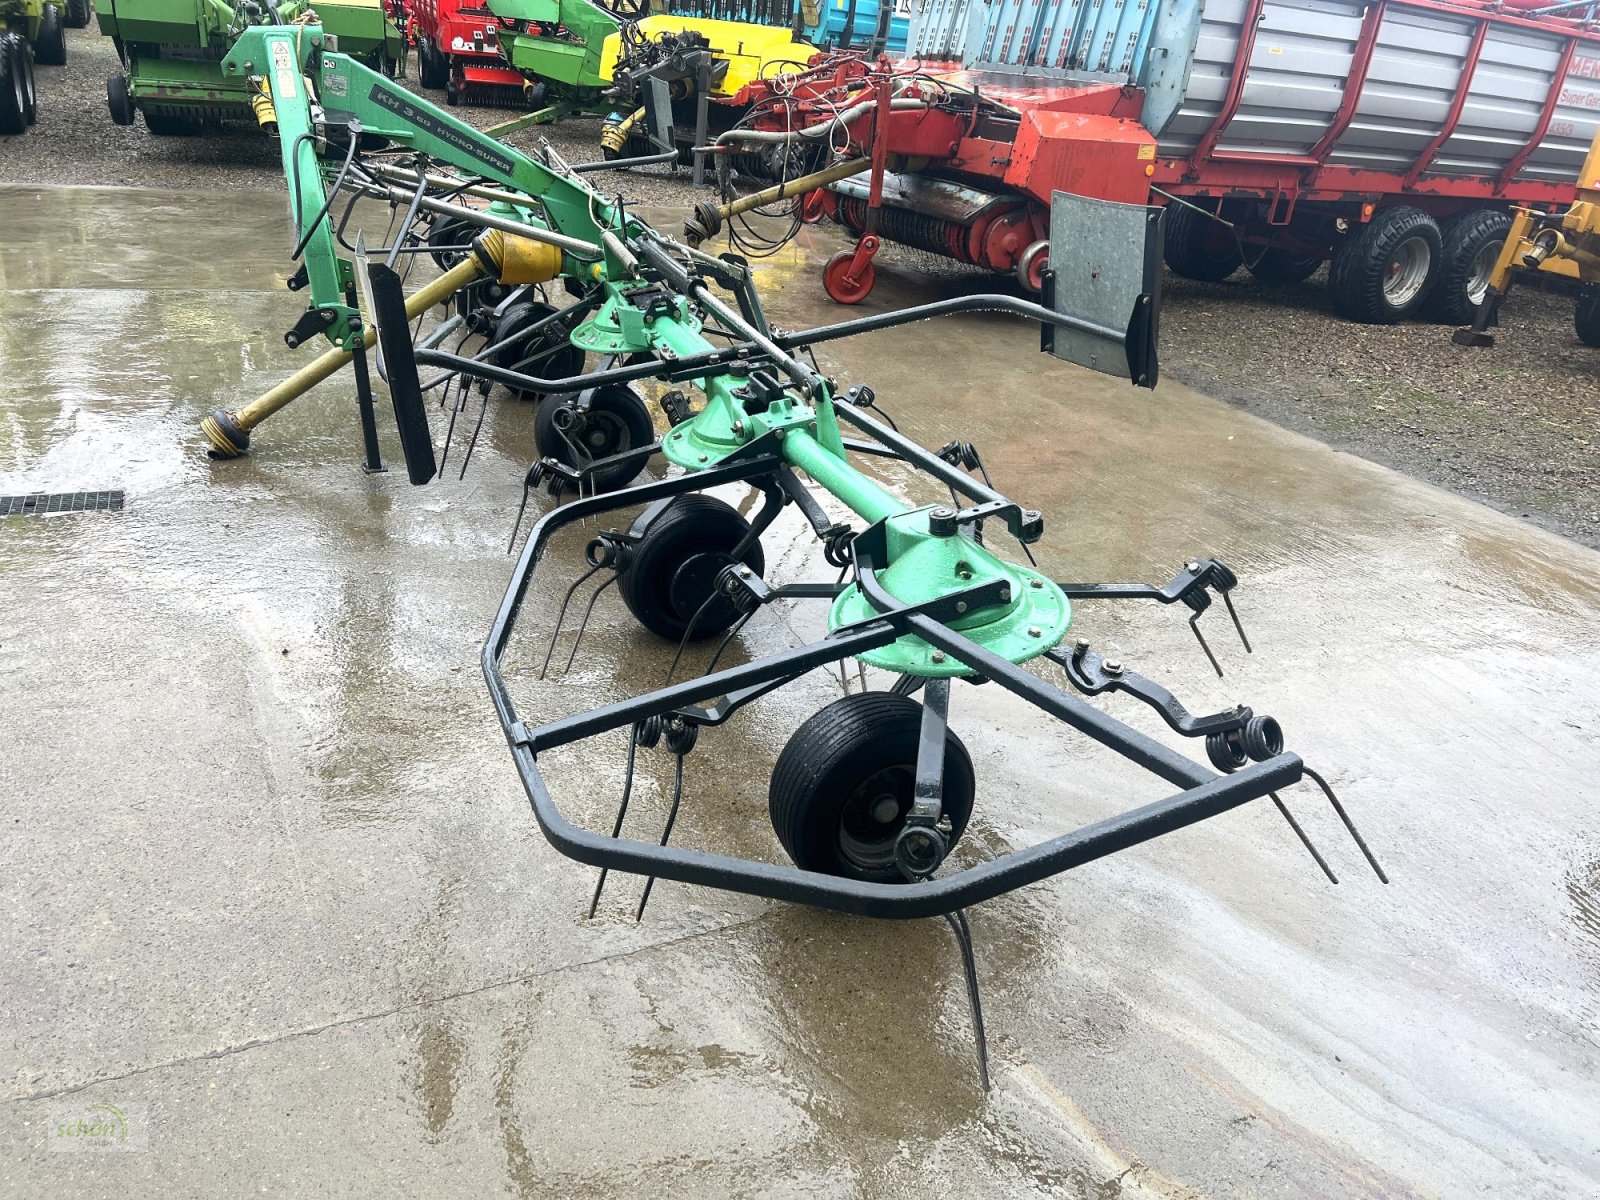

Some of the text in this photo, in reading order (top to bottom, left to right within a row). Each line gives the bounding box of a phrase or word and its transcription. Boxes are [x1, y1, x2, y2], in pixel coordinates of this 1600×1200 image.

[1560, 89, 1586, 106] Super
[376, 92, 399, 109] KH
[438, 128, 510, 171] HYDRO-SUPER
